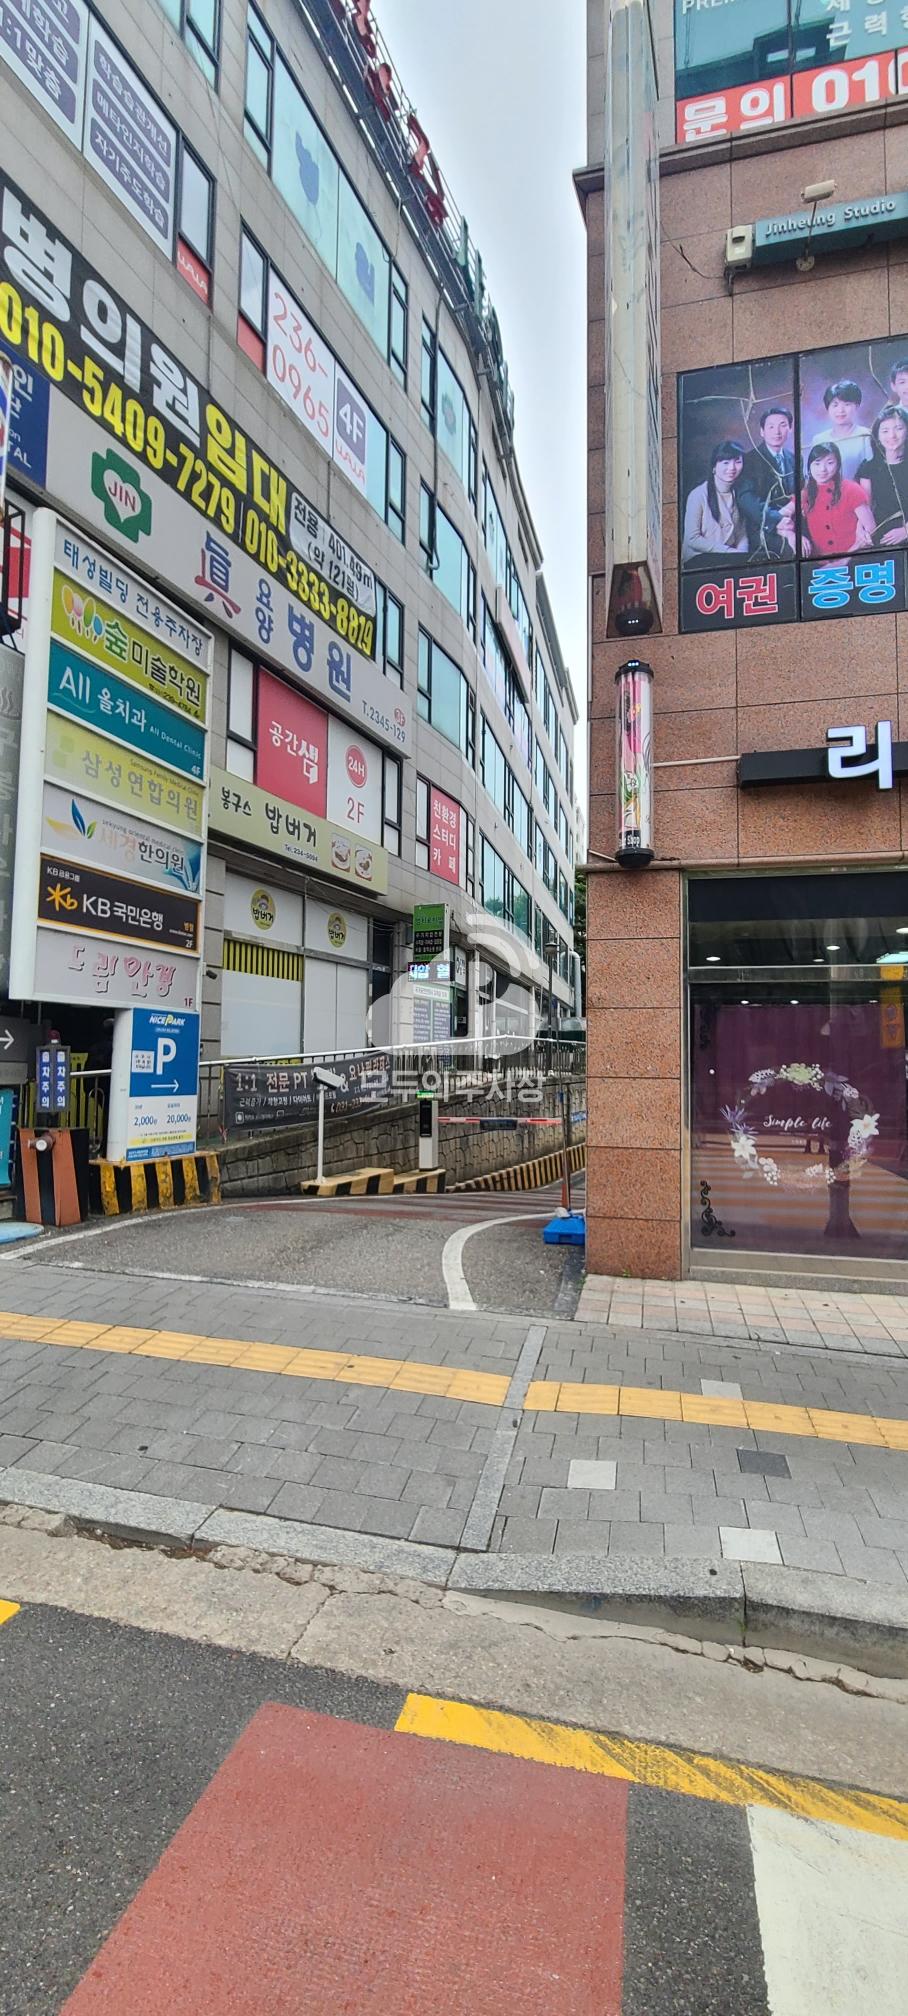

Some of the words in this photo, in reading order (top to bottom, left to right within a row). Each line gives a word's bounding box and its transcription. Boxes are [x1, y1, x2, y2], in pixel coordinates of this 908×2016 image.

[683, 81, 786, 142] 문의
[95, 90, 167, 191] 메타인지학습
[94, 130, 165, 230] 자기주도학습
[765, 211, 836, 238] Jinheung
[843, 198, 897, 221] Studio
[272, 292, 329, 378] 236-
[2, 186, 201, 448] 병의원
[206, 402, 287, 534] 임대
[272, 343, 330, 438] 0965
[338, 402, 364, 444] 4F
[0, 280, 235, 534] 010-5409-7279
[245, 512, 375, 656] 010-3333-8819
[108, 478, 137, 513] JIN
[294, 496, 319, 540] 전용
[63, 538, 130, 604] 태성빌딩
[136, 592, 205, 657] 전용주차장
[696, 572, 779, 620] 여권
[808, 558, 897, 610] 증명
[287, 602, 352, 703] 병원
[161, 731, 183, 749] Dental
[183, 744, 201, 760] Clinic
[347, 755, 365, 778] 24H
[827, 720, 893, 790] 리
[82, 750, 200, 822] 삼성연합의원
[191, 764, 201, 777] 4F
[220, 786, 252, 817] 봉구스
[265, 803, 317, 848] 밥버거
[346, 796, 366, 824] 2F
[433, 799, 457, 829] 친환경
[432, 823, 457, 851] 스터디
[82, 893, 164, 931] KB국민은행
[252, 906, 274, 923] 밥버거
[328, 928, 345, 942] 밥버거
[184, 997, 194, 1008] 1F
[156, 1037, 177, 1075] P
[236, 1072, 258, 1092] 1:1
[266, 1071, 290, 1094] 전문
[293, 1071, 308, 1090] PT
[763, 1114, 807, 1131] Simple
[811, 1116, 833, 1130] life
